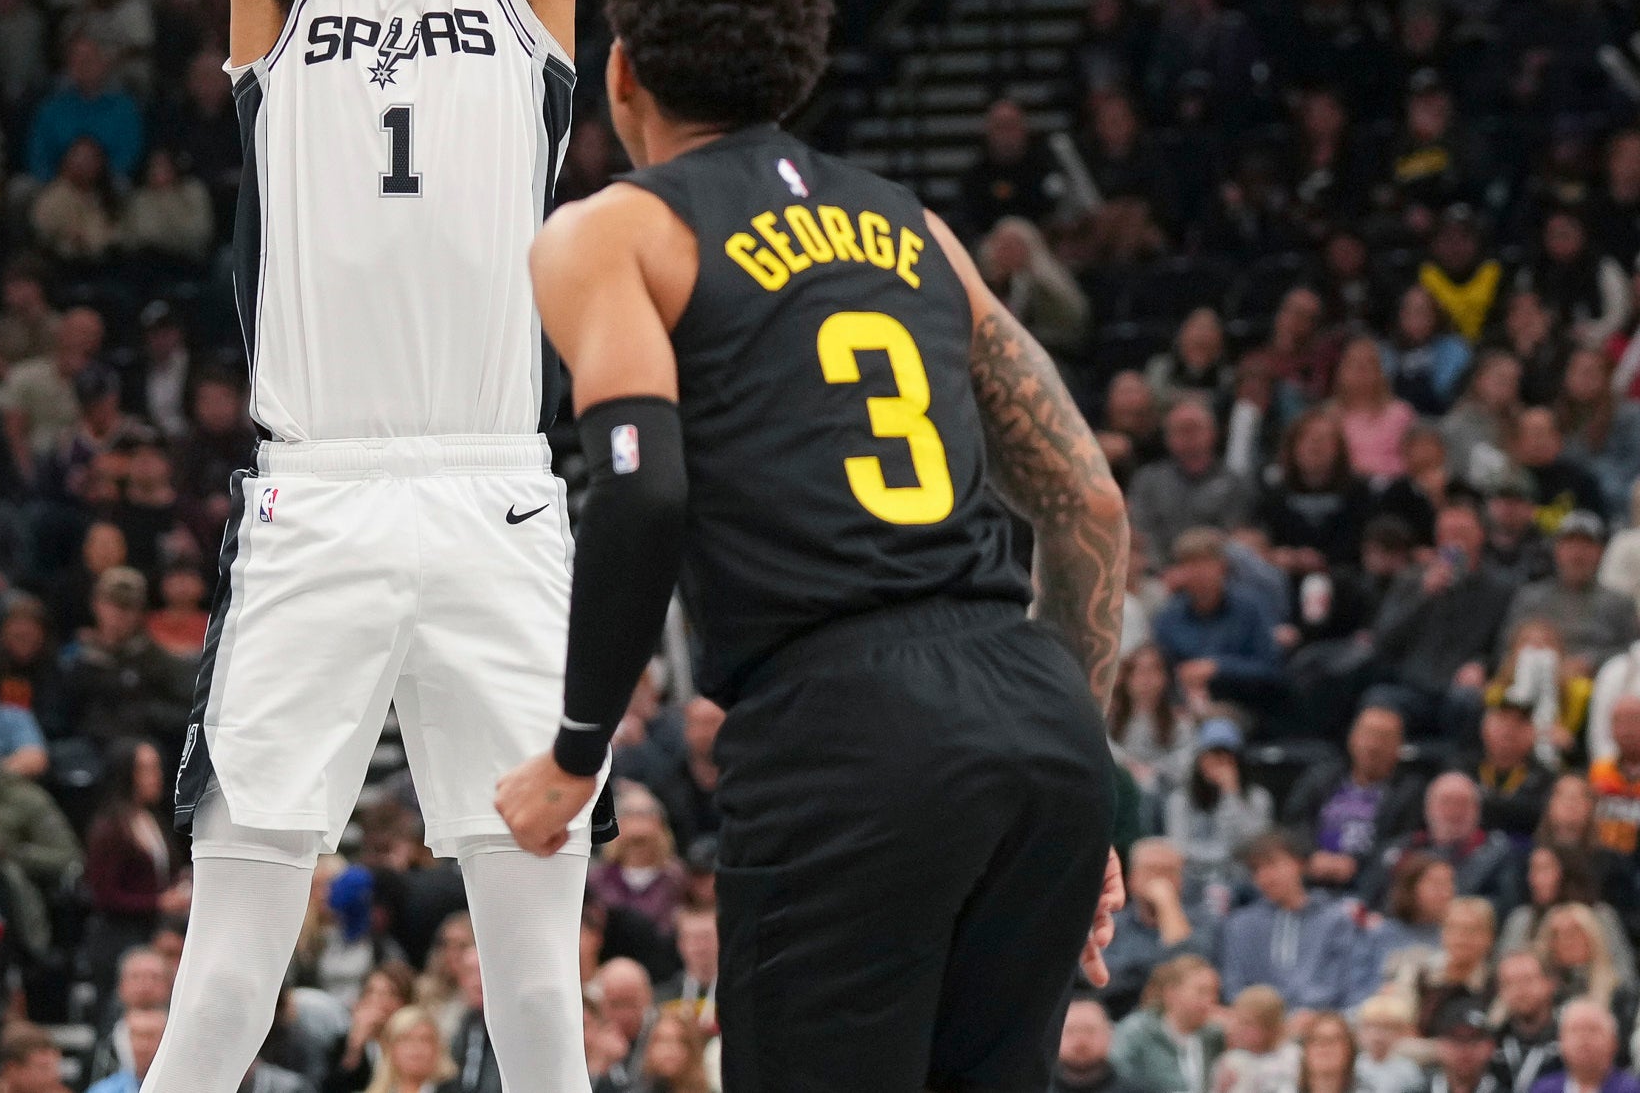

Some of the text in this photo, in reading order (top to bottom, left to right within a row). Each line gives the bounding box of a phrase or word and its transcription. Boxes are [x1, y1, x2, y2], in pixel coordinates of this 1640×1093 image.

[304, 7, 496, 74] SPURS
[378, 103, 423, 198] 1
[725, 204, 925, 292] GEORGE
[817, 311, 955, 525] 3
